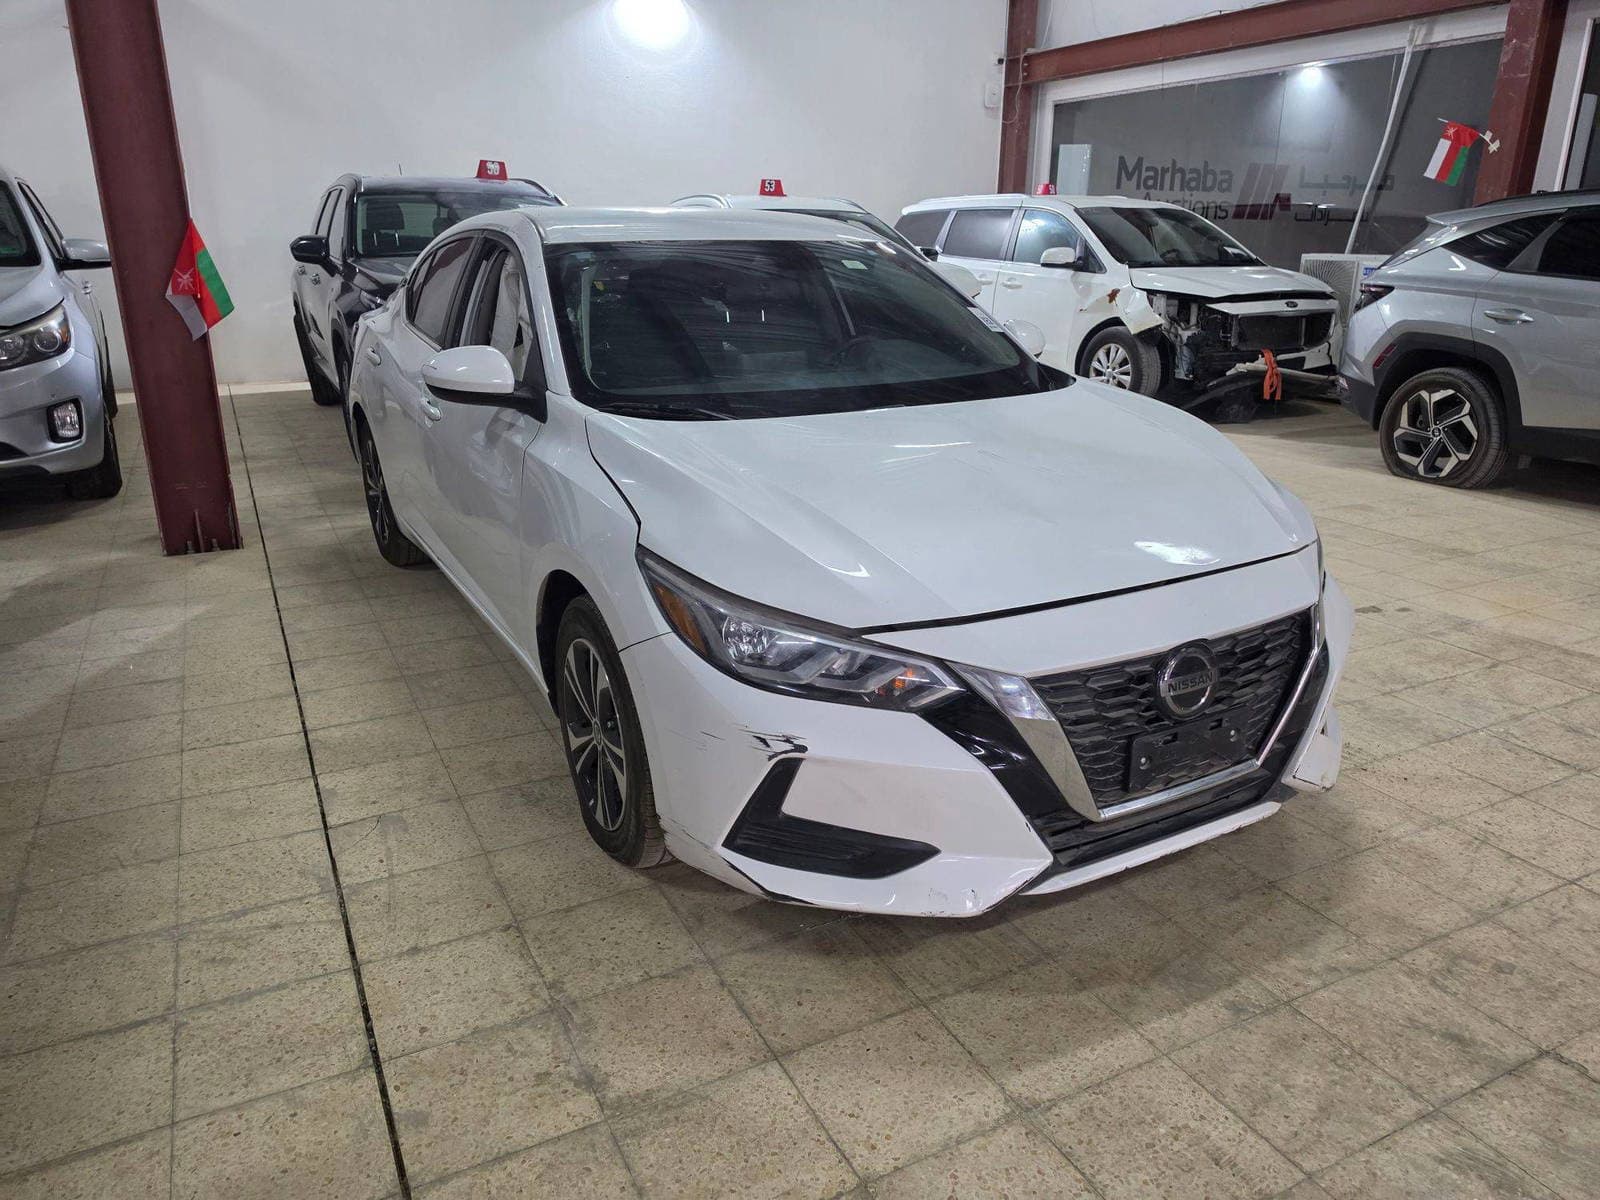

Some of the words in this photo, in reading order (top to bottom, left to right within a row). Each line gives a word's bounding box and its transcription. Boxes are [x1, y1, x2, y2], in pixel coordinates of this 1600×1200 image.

[1115, 155, 1233, 192] Marhaba
[764, 180, 776, 192] 53
[1168, 671, 1213, 693] NISSAN
